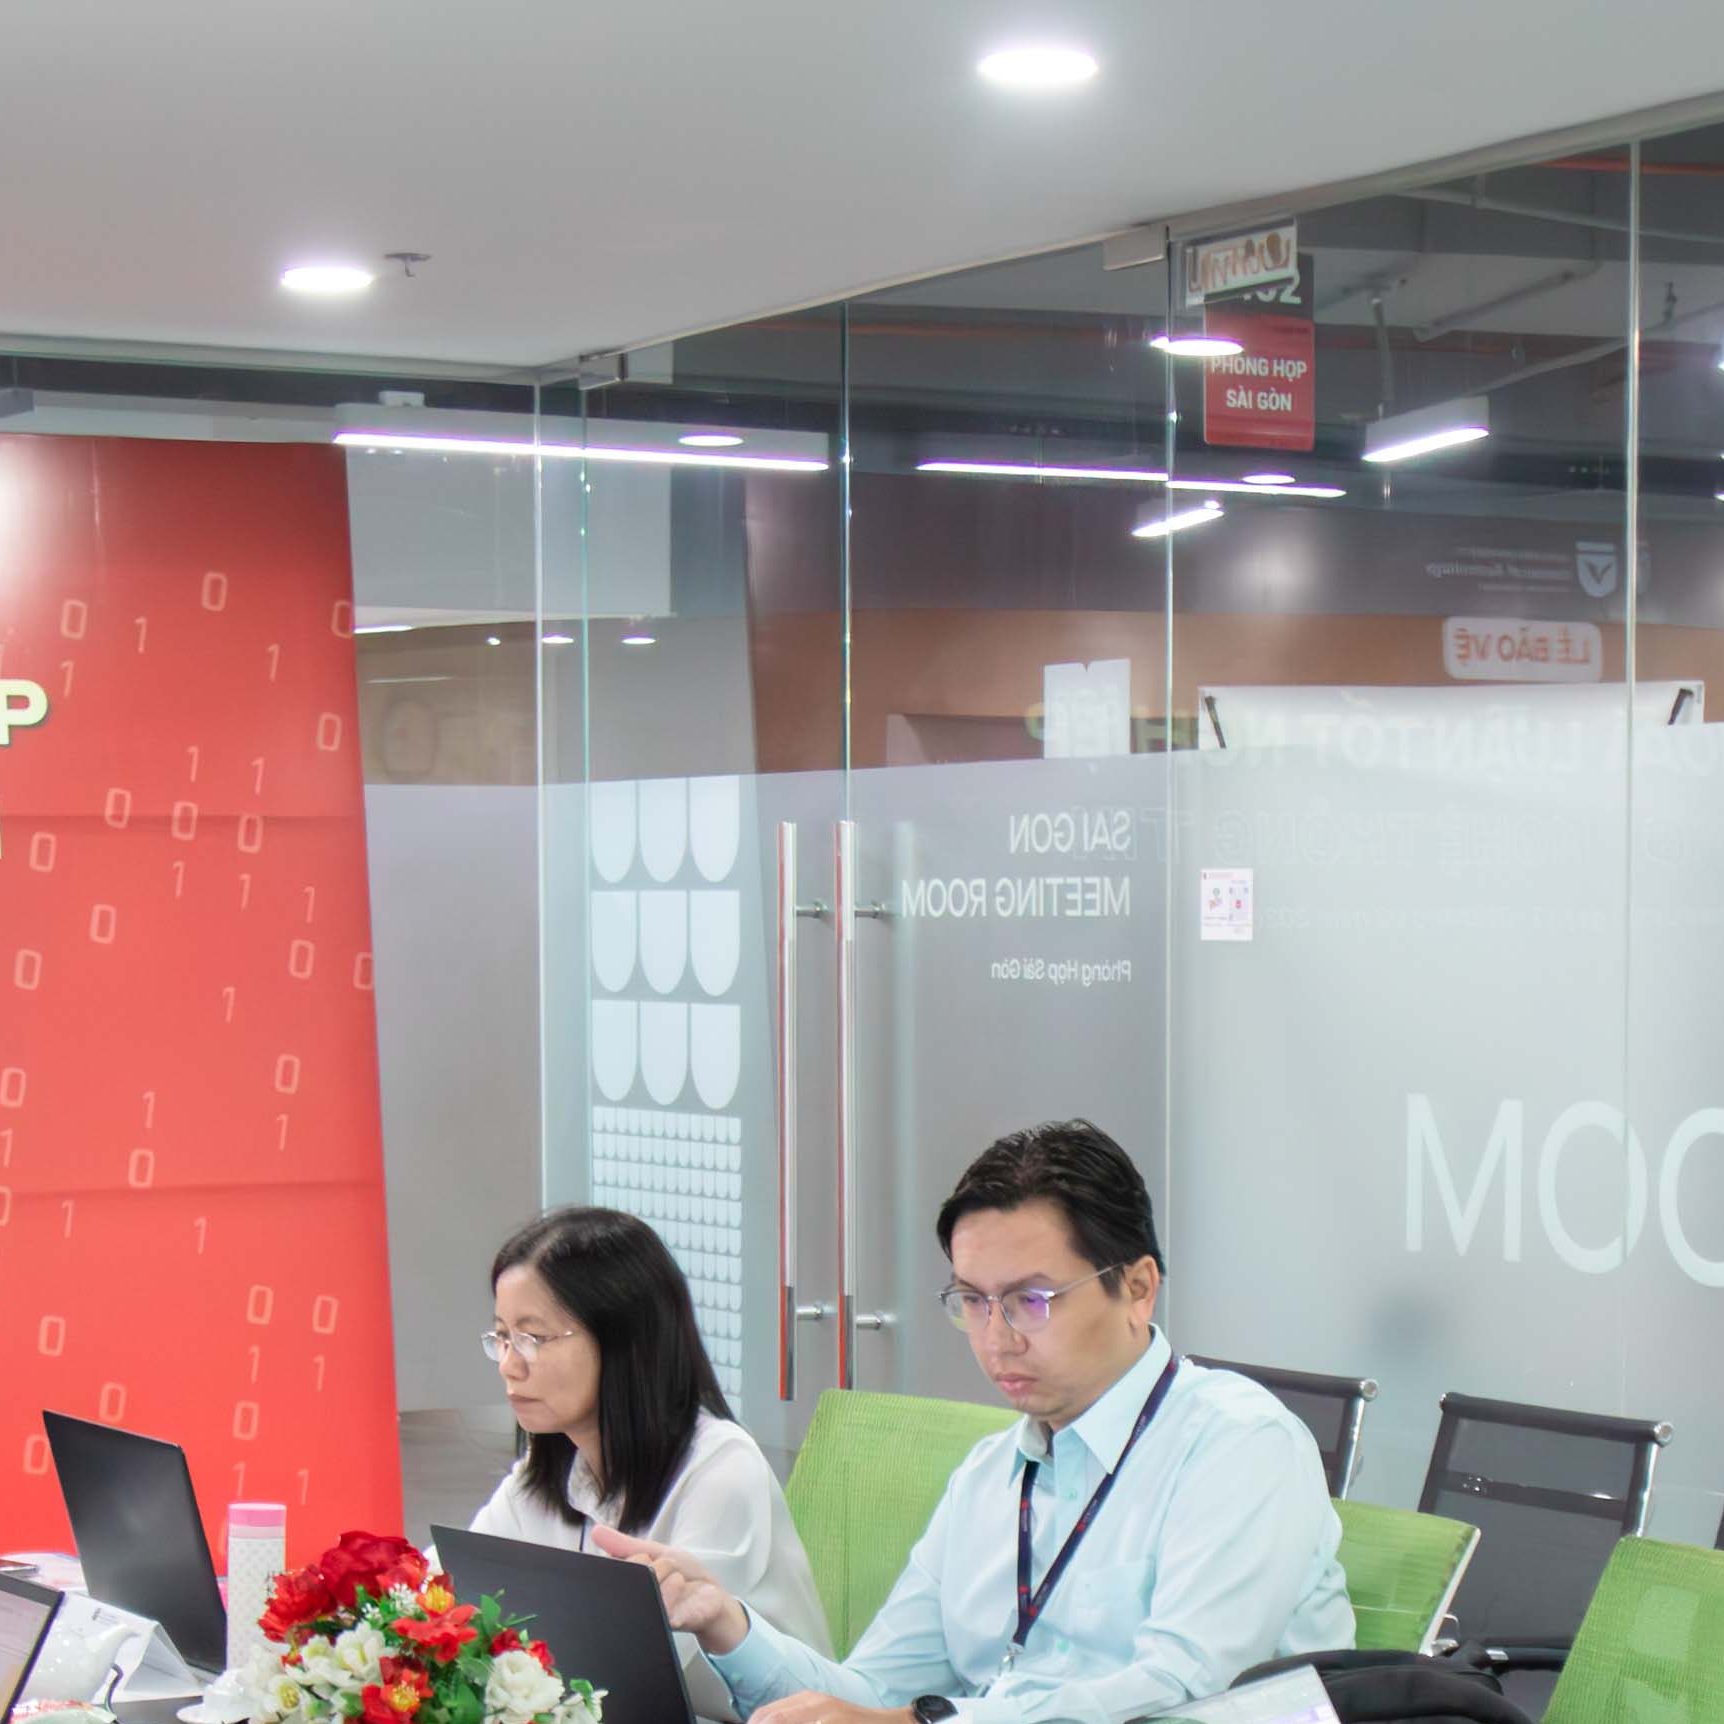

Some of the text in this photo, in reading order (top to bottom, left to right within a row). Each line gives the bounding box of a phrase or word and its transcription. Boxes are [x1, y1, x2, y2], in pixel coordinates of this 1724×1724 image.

[1273, 358, 1308, 383] HỌP
[1226, 384, 1293, 412] SÀI GÒN
